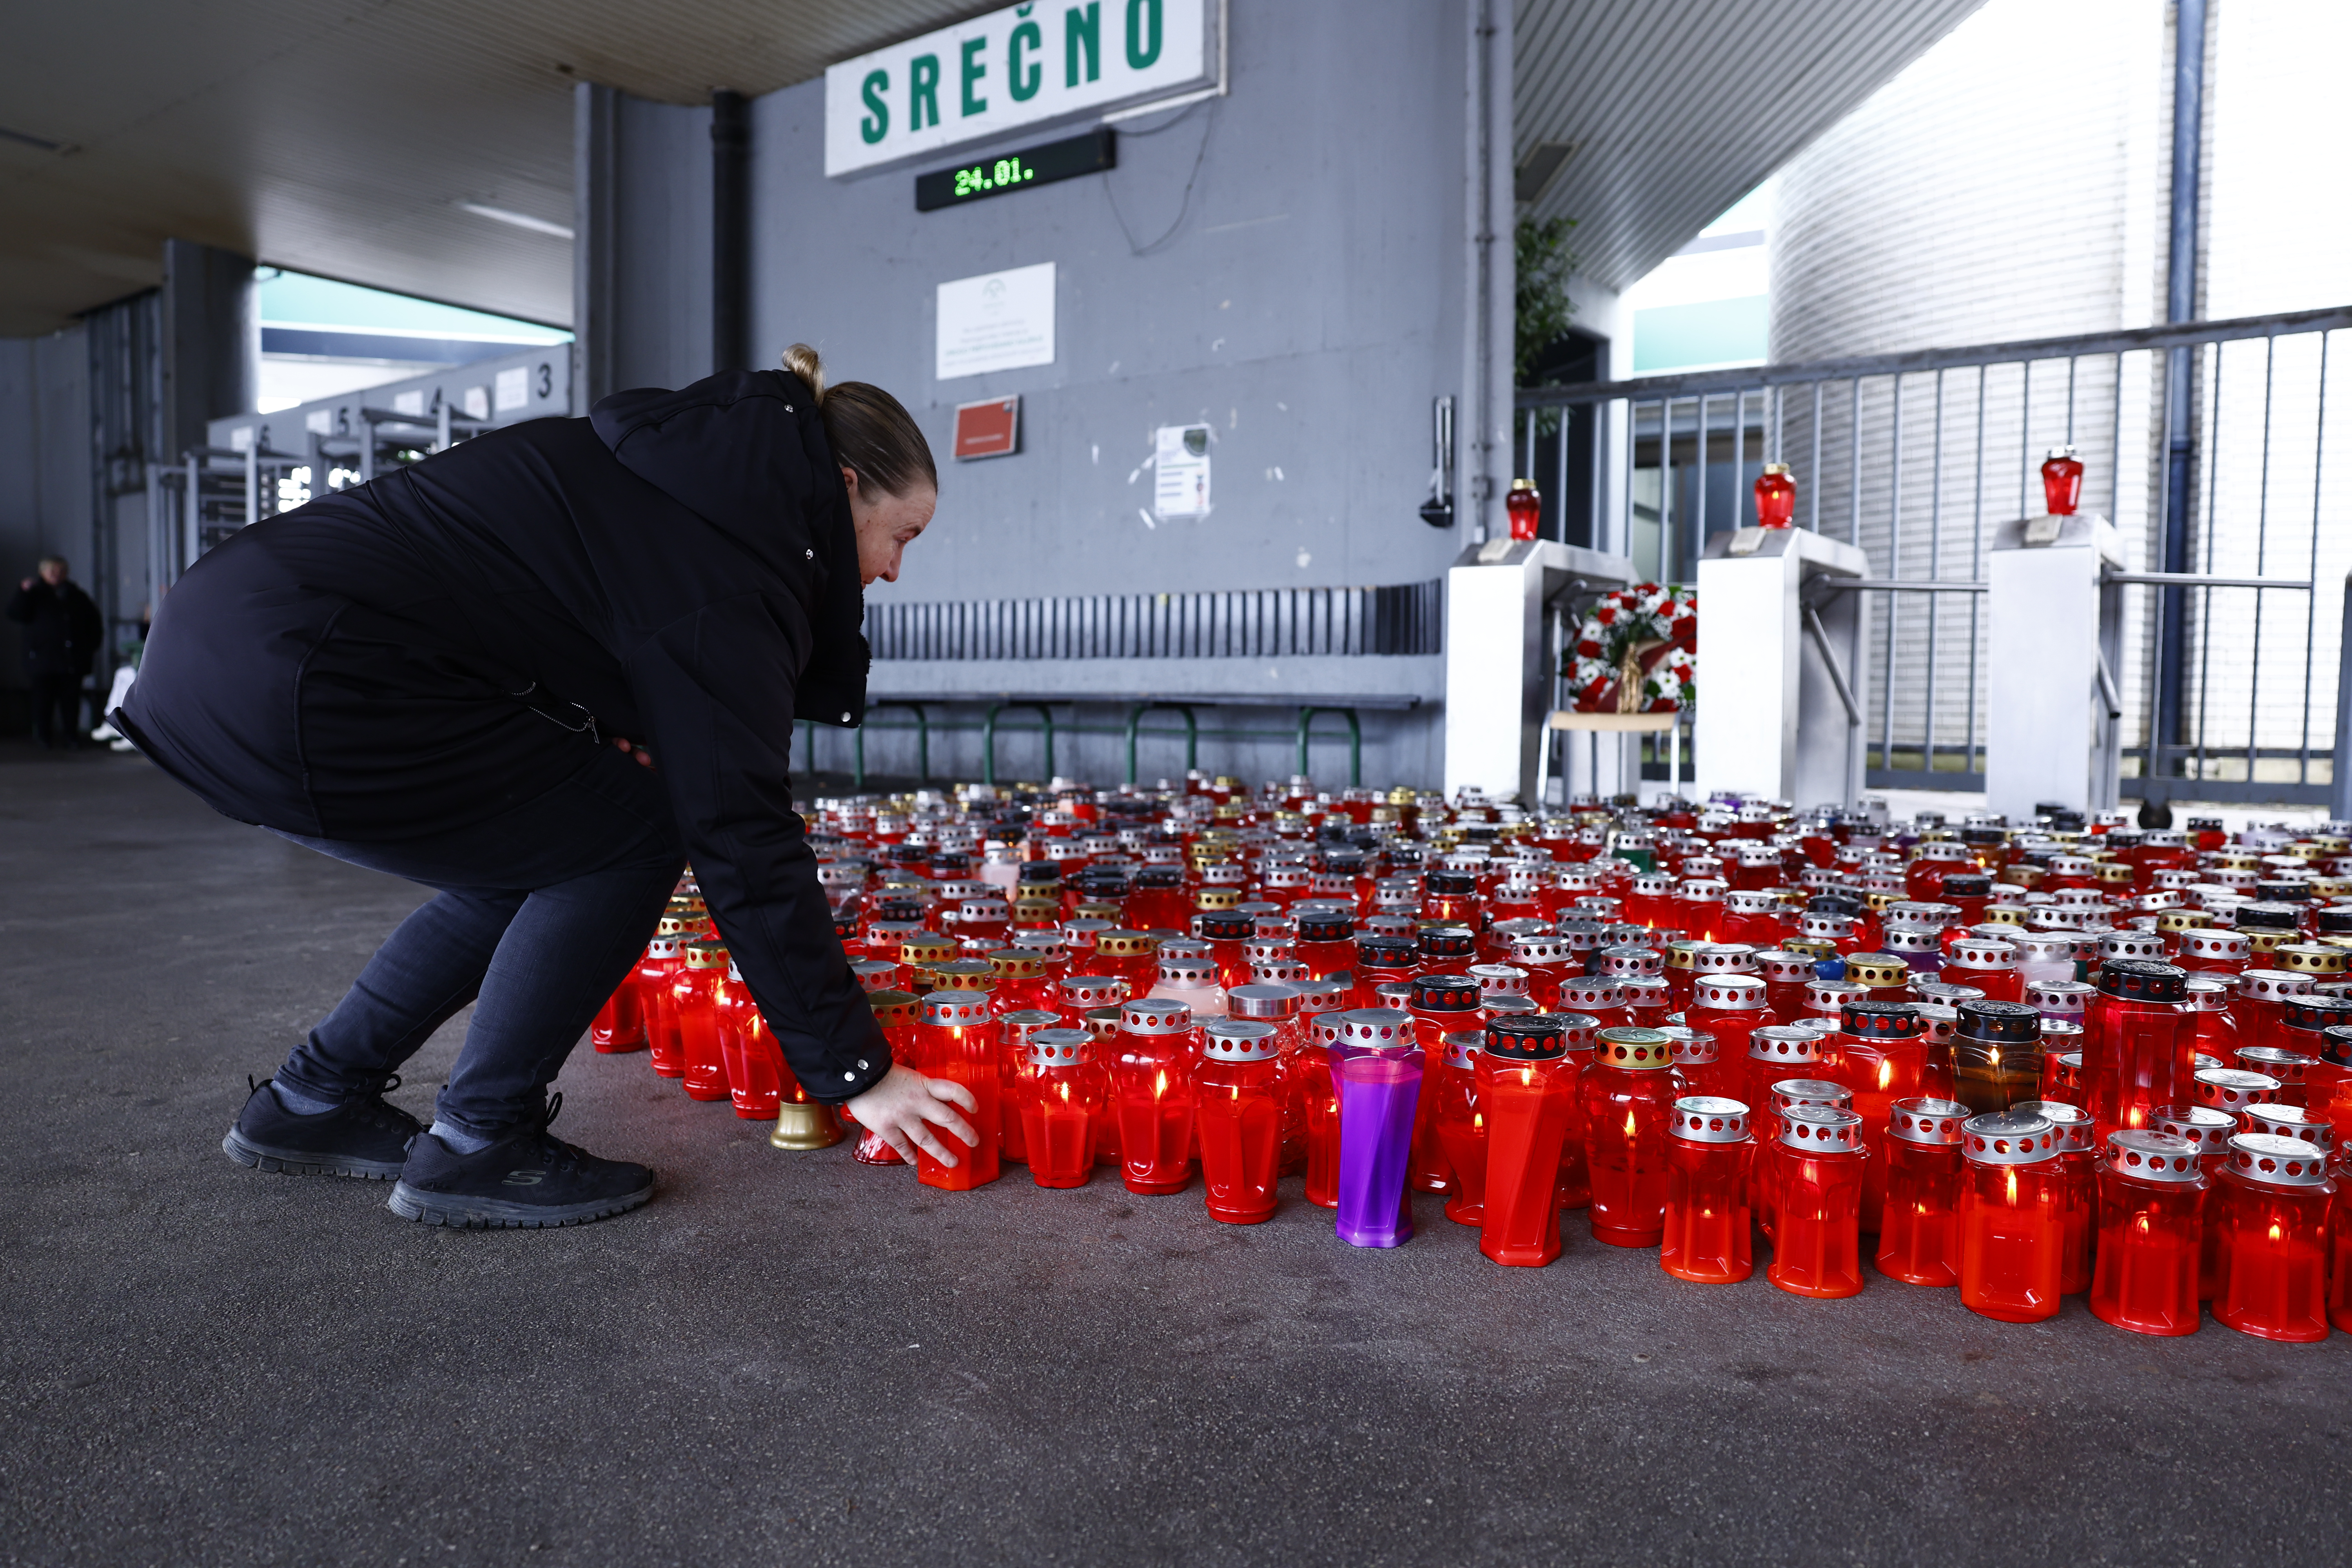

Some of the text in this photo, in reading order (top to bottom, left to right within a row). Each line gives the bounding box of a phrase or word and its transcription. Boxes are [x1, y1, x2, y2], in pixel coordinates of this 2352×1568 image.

[861, 0, 1162, 145] SREČNO
[955, 157, 1034, 196] 24.01.
[537, 362, 552, 399] 3
[429, 385, 442, 414] 4
[339, 406, 350, 437] 5
